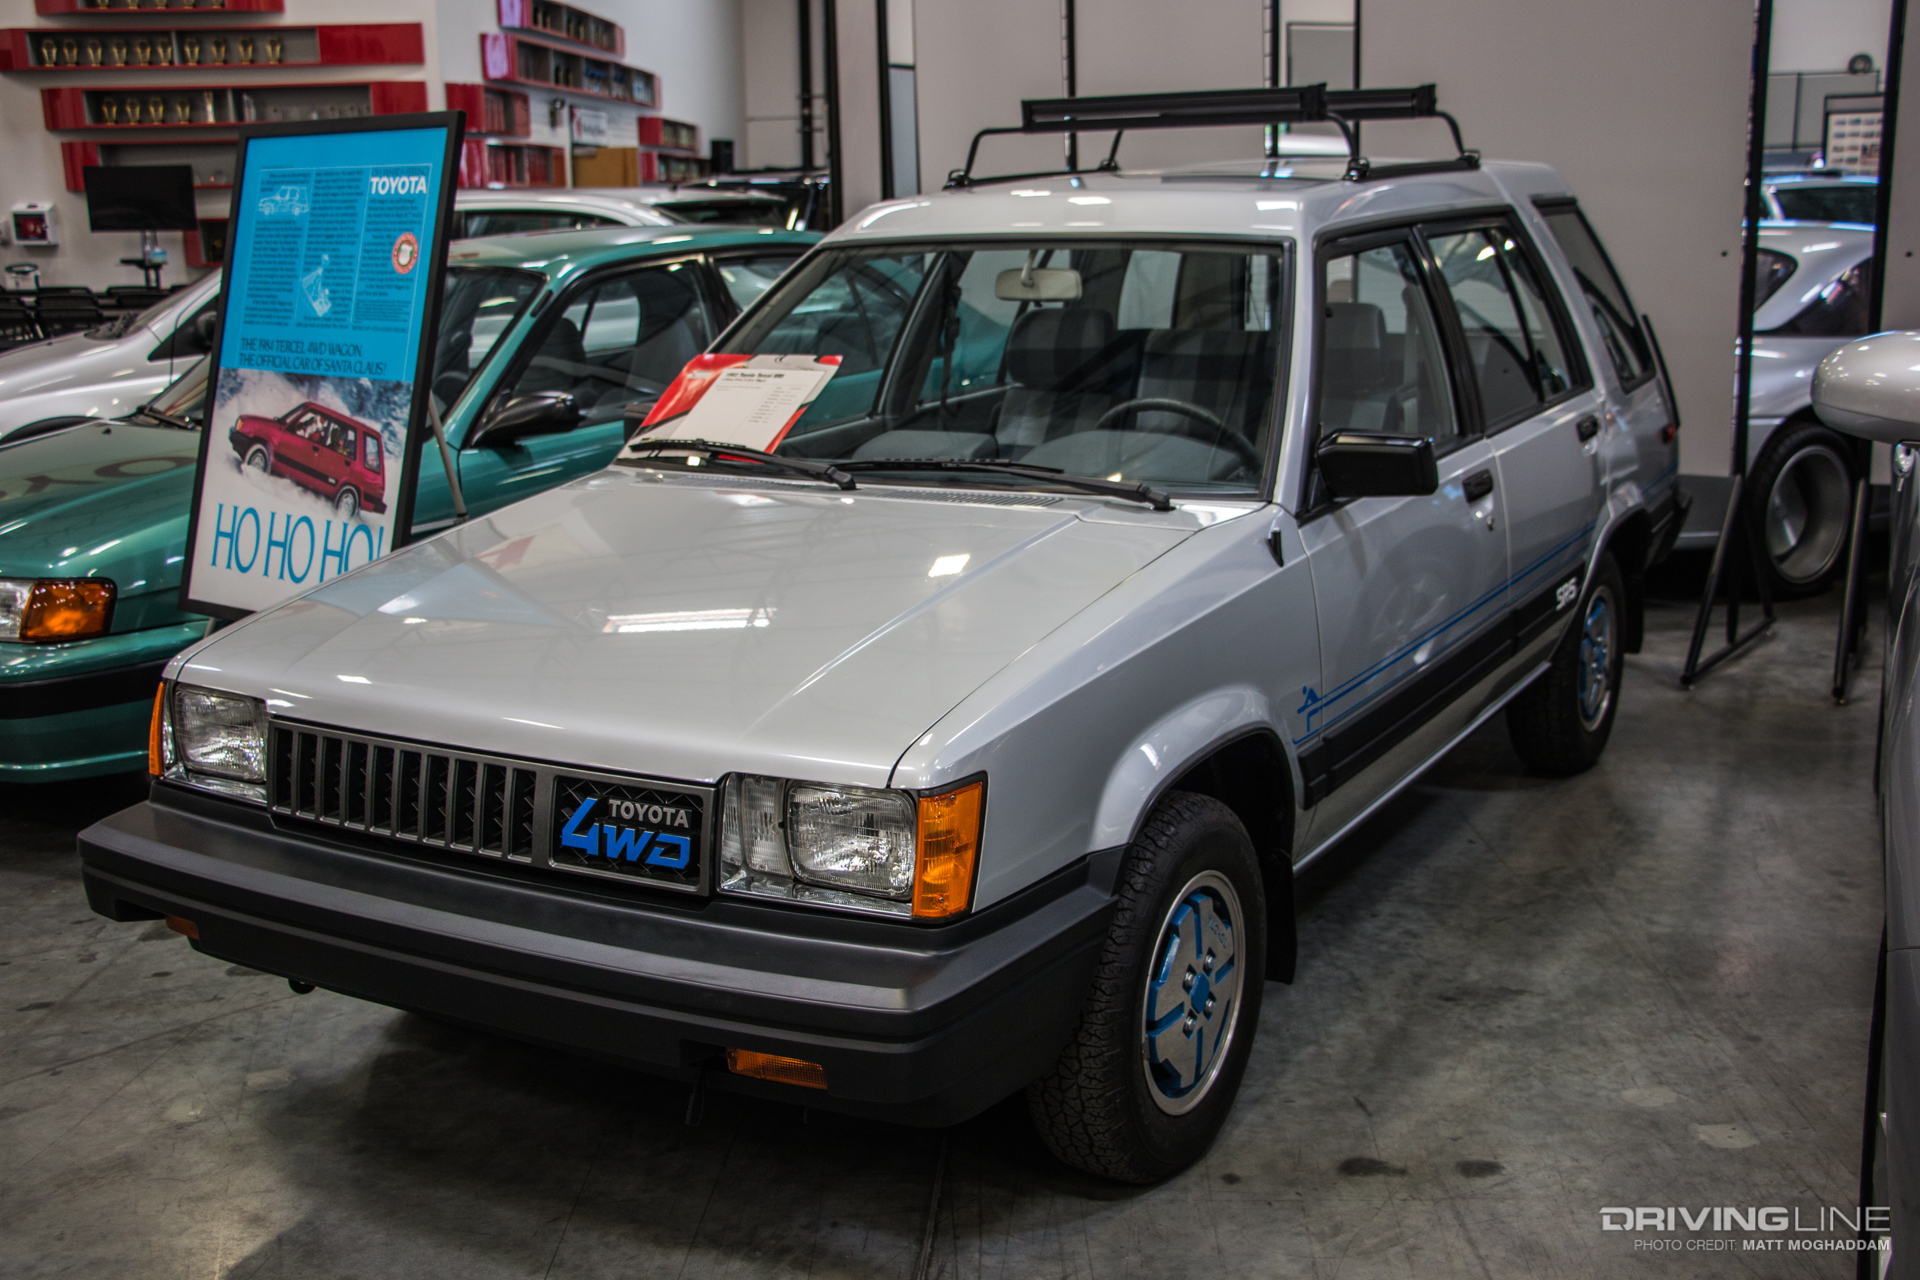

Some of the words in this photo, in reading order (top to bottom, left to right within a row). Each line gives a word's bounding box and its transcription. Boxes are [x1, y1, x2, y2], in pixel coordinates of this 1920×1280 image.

[370, 176, 427, 195] TOYOTA
[241, 338, 257, 351] THE
[258, 339, 274, 352] 1984
[276, 340, 306, 354] TERCEL
[307, 342, 327, 355] 4WD
[239, 353, 255, 366] THE
[256, 355, 292, 369] OFFICIAL
[293, 357, 310, 370] CAR
[311, 358, 325, 371] OF
[325, 359, 352, 373] SANTA
[354, 361, 387, 375] CLAUS!
[211, 503, 260, 574] HO
[263, 511, 315, 584] HO
[609, 799, 689, 828] TOYOTA
[561, 797, 690, 869] 4WD
